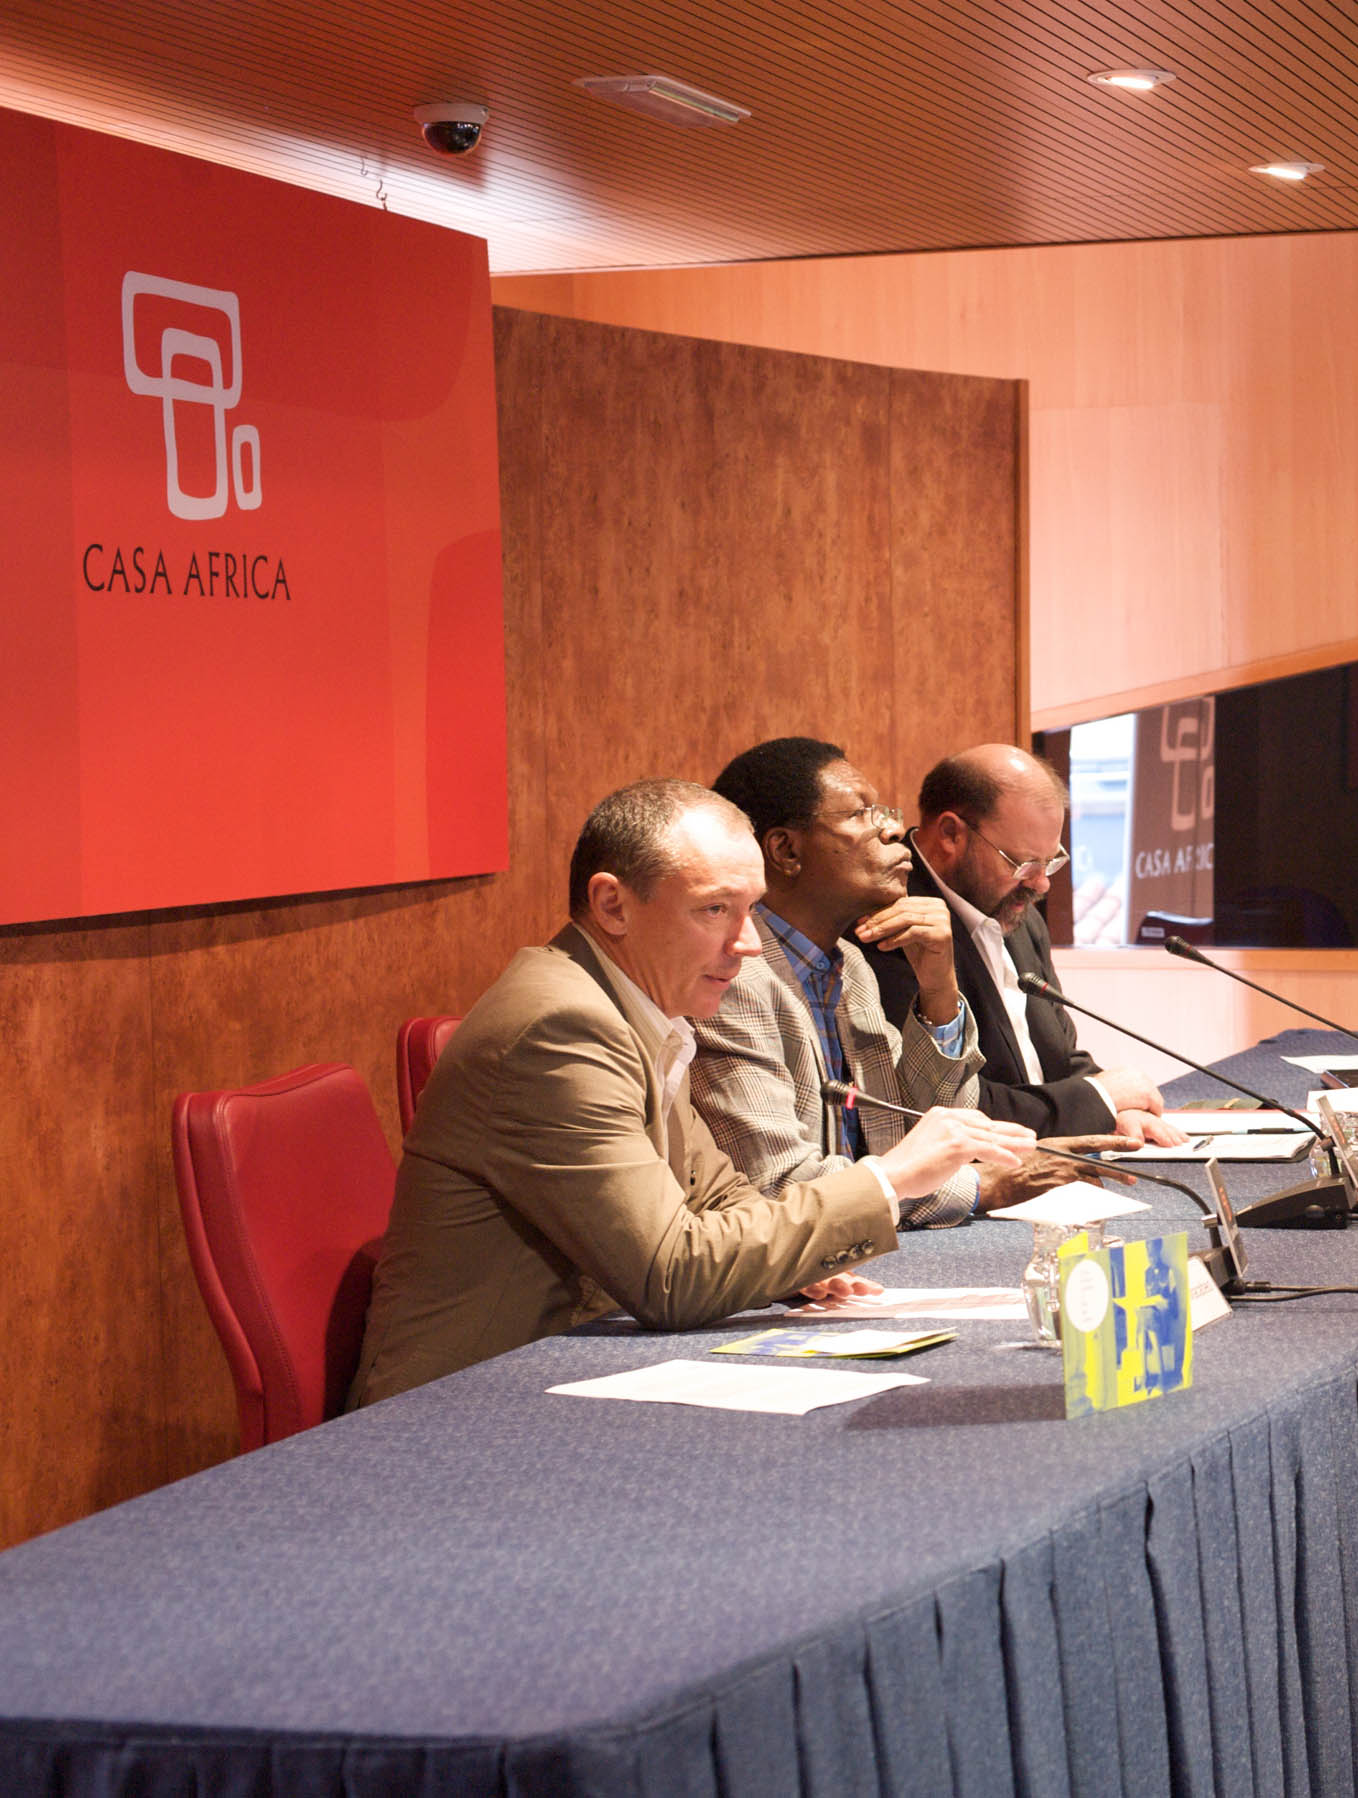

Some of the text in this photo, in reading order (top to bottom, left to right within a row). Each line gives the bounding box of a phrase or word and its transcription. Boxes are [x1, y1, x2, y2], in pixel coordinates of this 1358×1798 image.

[83, 543, 292, 601] CASA AFRICA
[1135, 849, 1171, 879] CASA
